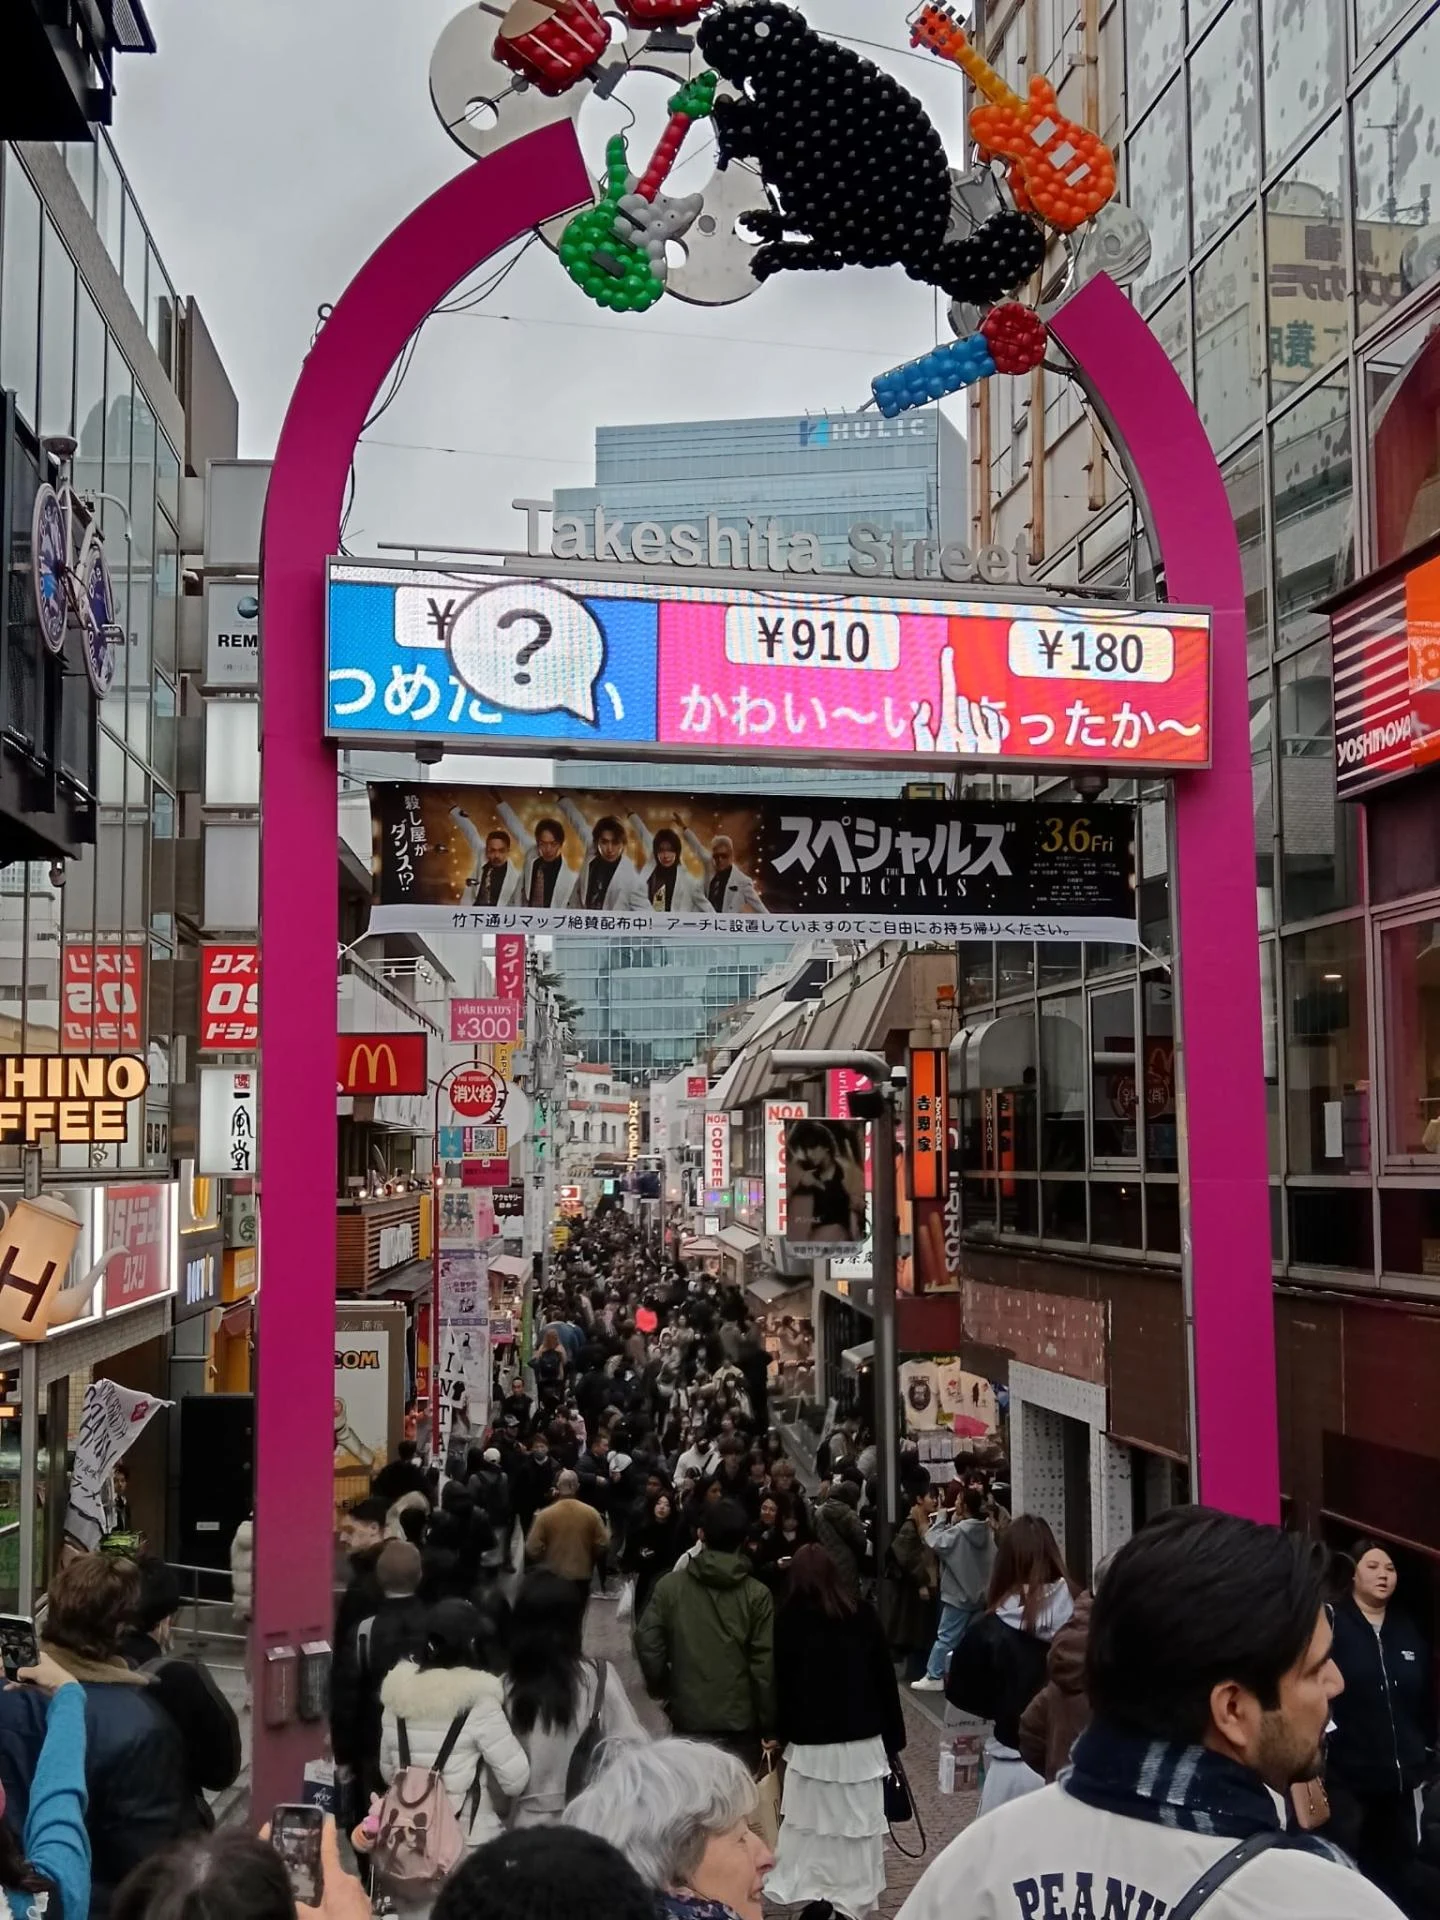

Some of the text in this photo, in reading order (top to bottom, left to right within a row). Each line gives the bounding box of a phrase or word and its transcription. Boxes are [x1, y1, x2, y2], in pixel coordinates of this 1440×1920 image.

[832, 419, 924, 441] HULIC
[512, 498, 1041, 586] Takeshita Street
[757, 616, 871, 664] ¥910
[1037, 628, 1144, 674] ¥180
[1337, 714, 1412, 767] YOSHINOYA
[404, 794, 428, 857] 殺し屋が
[1041, 817, 1113, 853] 3.6 Fri
[770, 815, 1016, 876] スペシャルズ
[817, 876, 967, 896] SPECIALS
[210, 954, 258, 974] クス
[457, 1017, 511, 1039] ¥300
[458, 1003, 486, 1015] PARIS
[5, 1056, 146, 1098] HINO
[453, 1084, 494, 1103] 消火栓
[706, 1115, 728, 1124] NOA
[768, 1106, 805, 1120] NOA
[711, 1127, 723, 1187] COFFEE
[1013, 1871, 1177, 1920] PEANU
